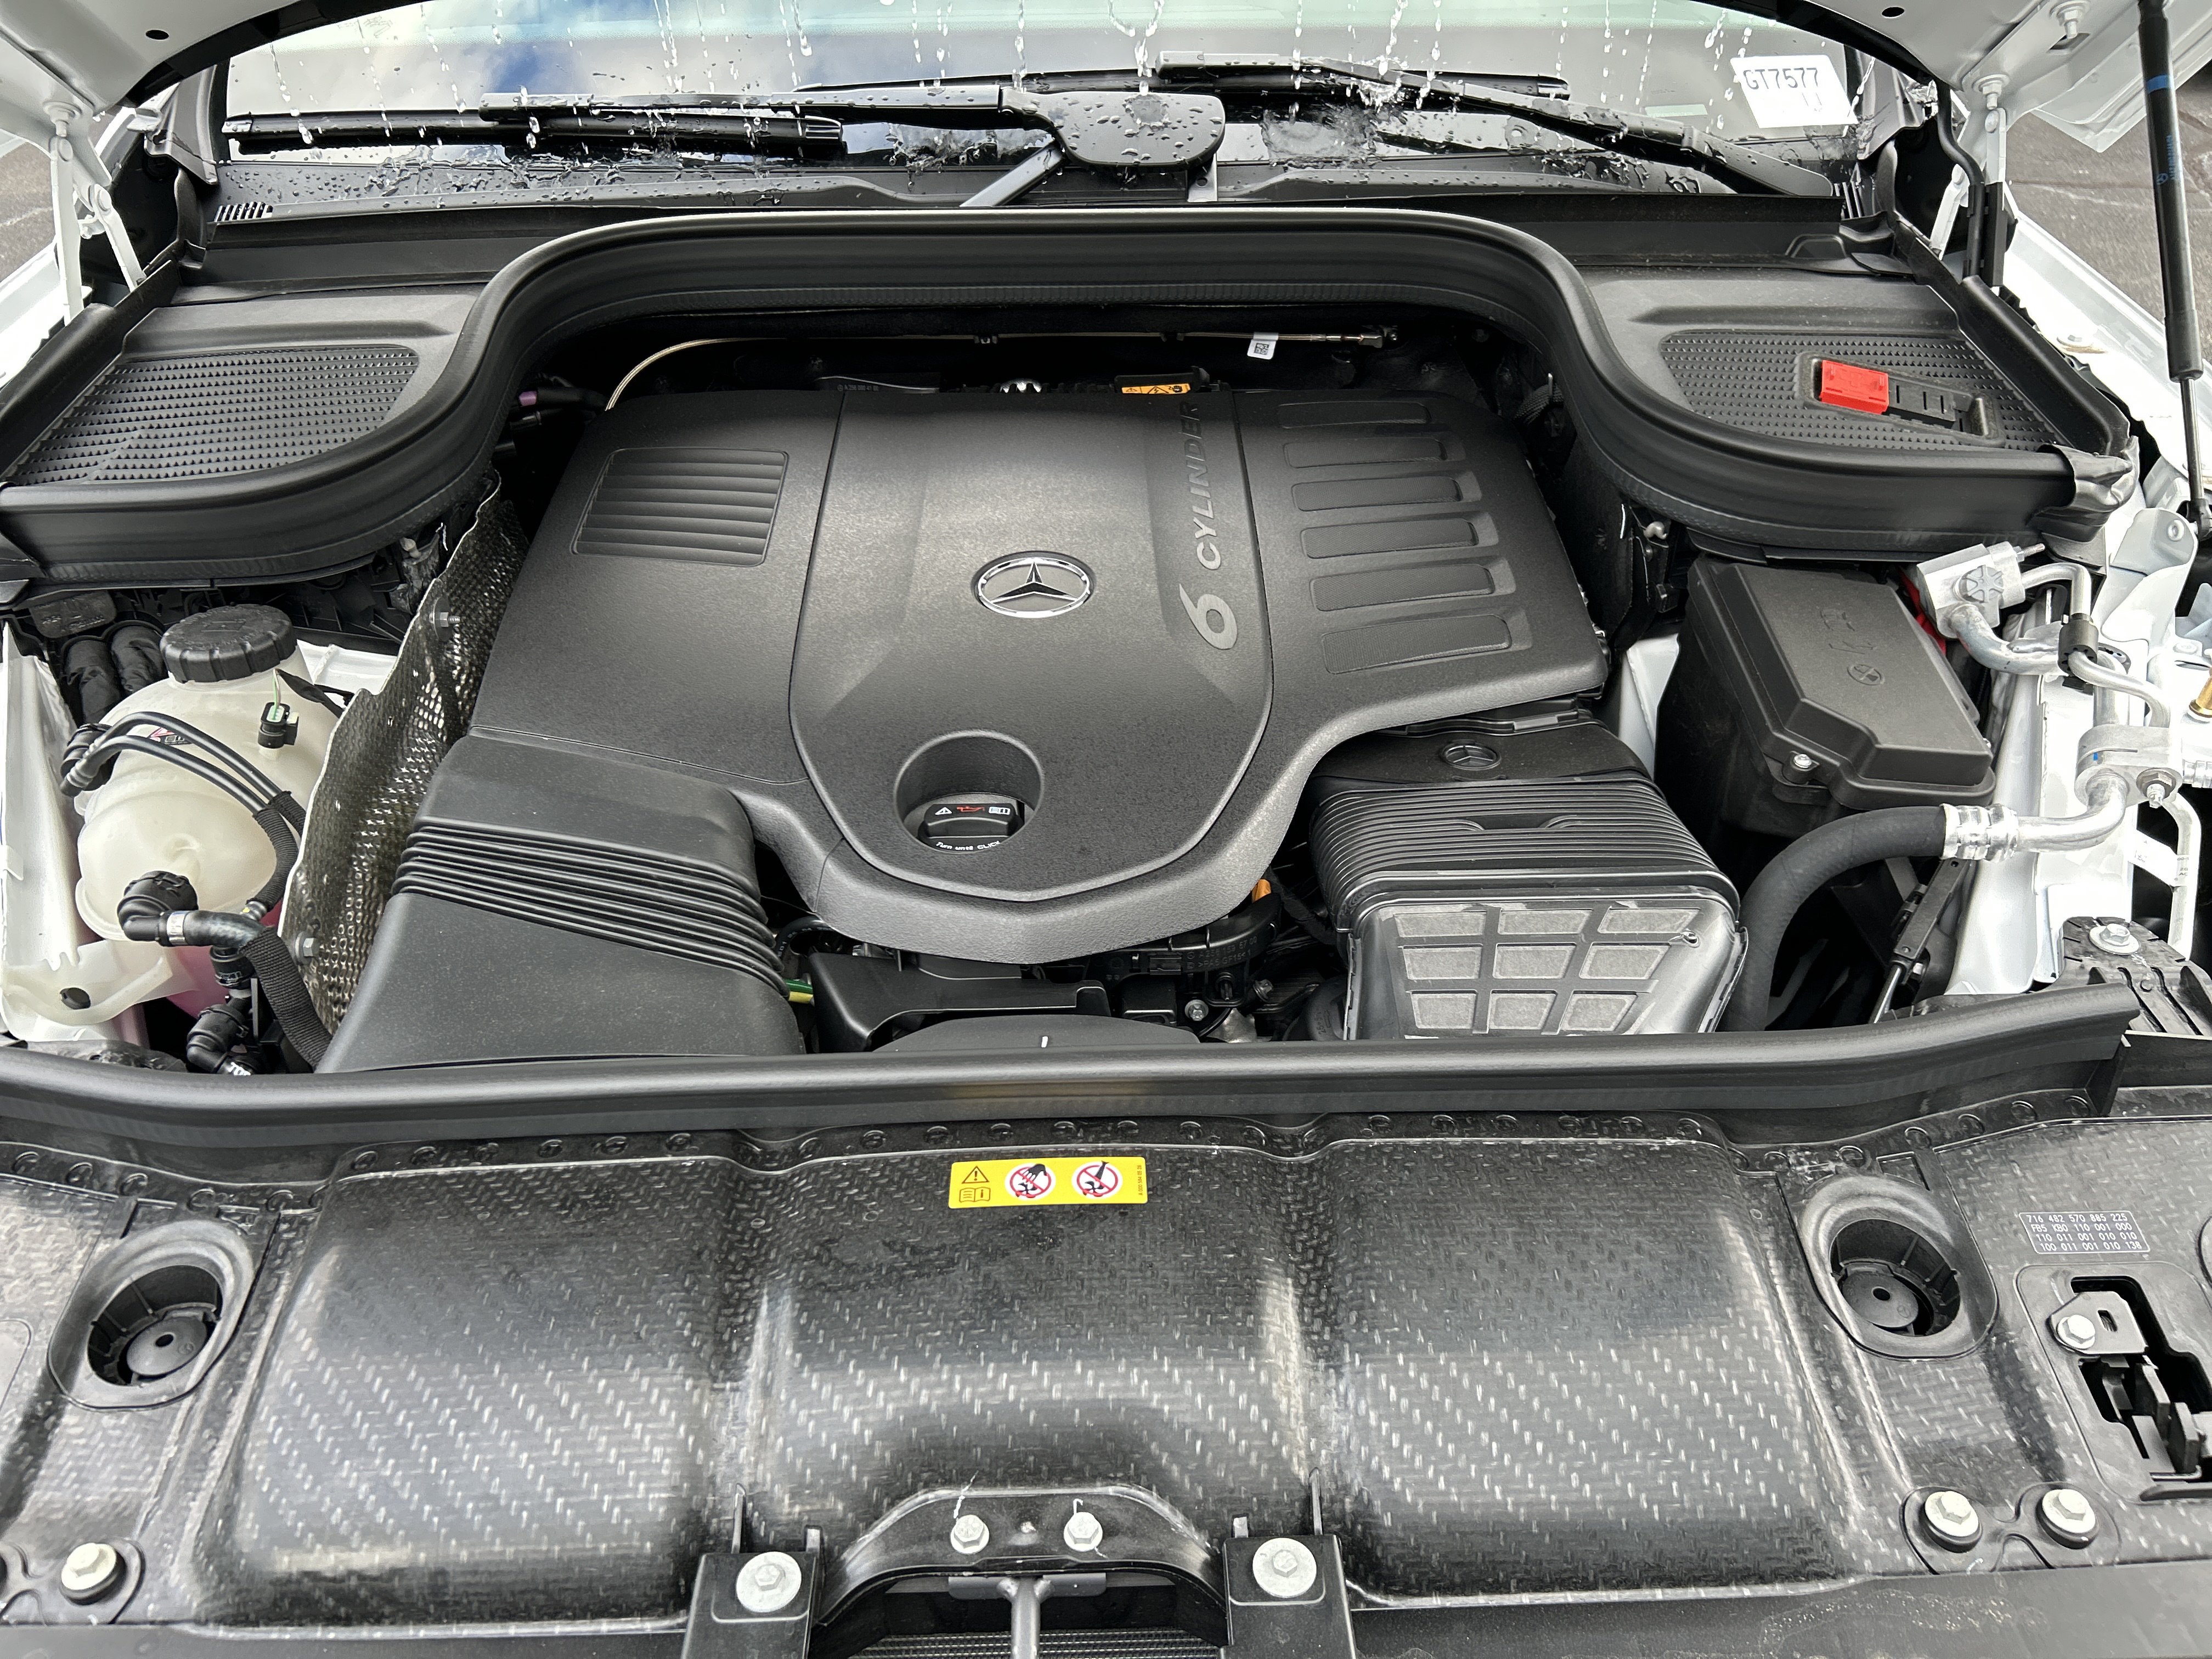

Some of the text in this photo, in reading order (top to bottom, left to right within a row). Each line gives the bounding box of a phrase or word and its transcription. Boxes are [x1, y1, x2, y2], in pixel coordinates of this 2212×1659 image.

[1743, 67, 1818, 89] GT7577
[1179, 402, 1238, 650] 6 CYLINDER
[936, 842, 952, 850] Turn
[977, 840, 1001, 850] CLICK
[2025, 1213, 2128, 1223] 716 482 570 885 225
[2074, 1223, 2090, 1232] 110
[2094, 1223, 2111, 1231] 001
[2115, 1222, 2132, 1231] 000
[2036, 1232, 2137, 1242] 110 011 001 010 010
[2040, 1241, 2142, 1251] 100 011 001 010 138
